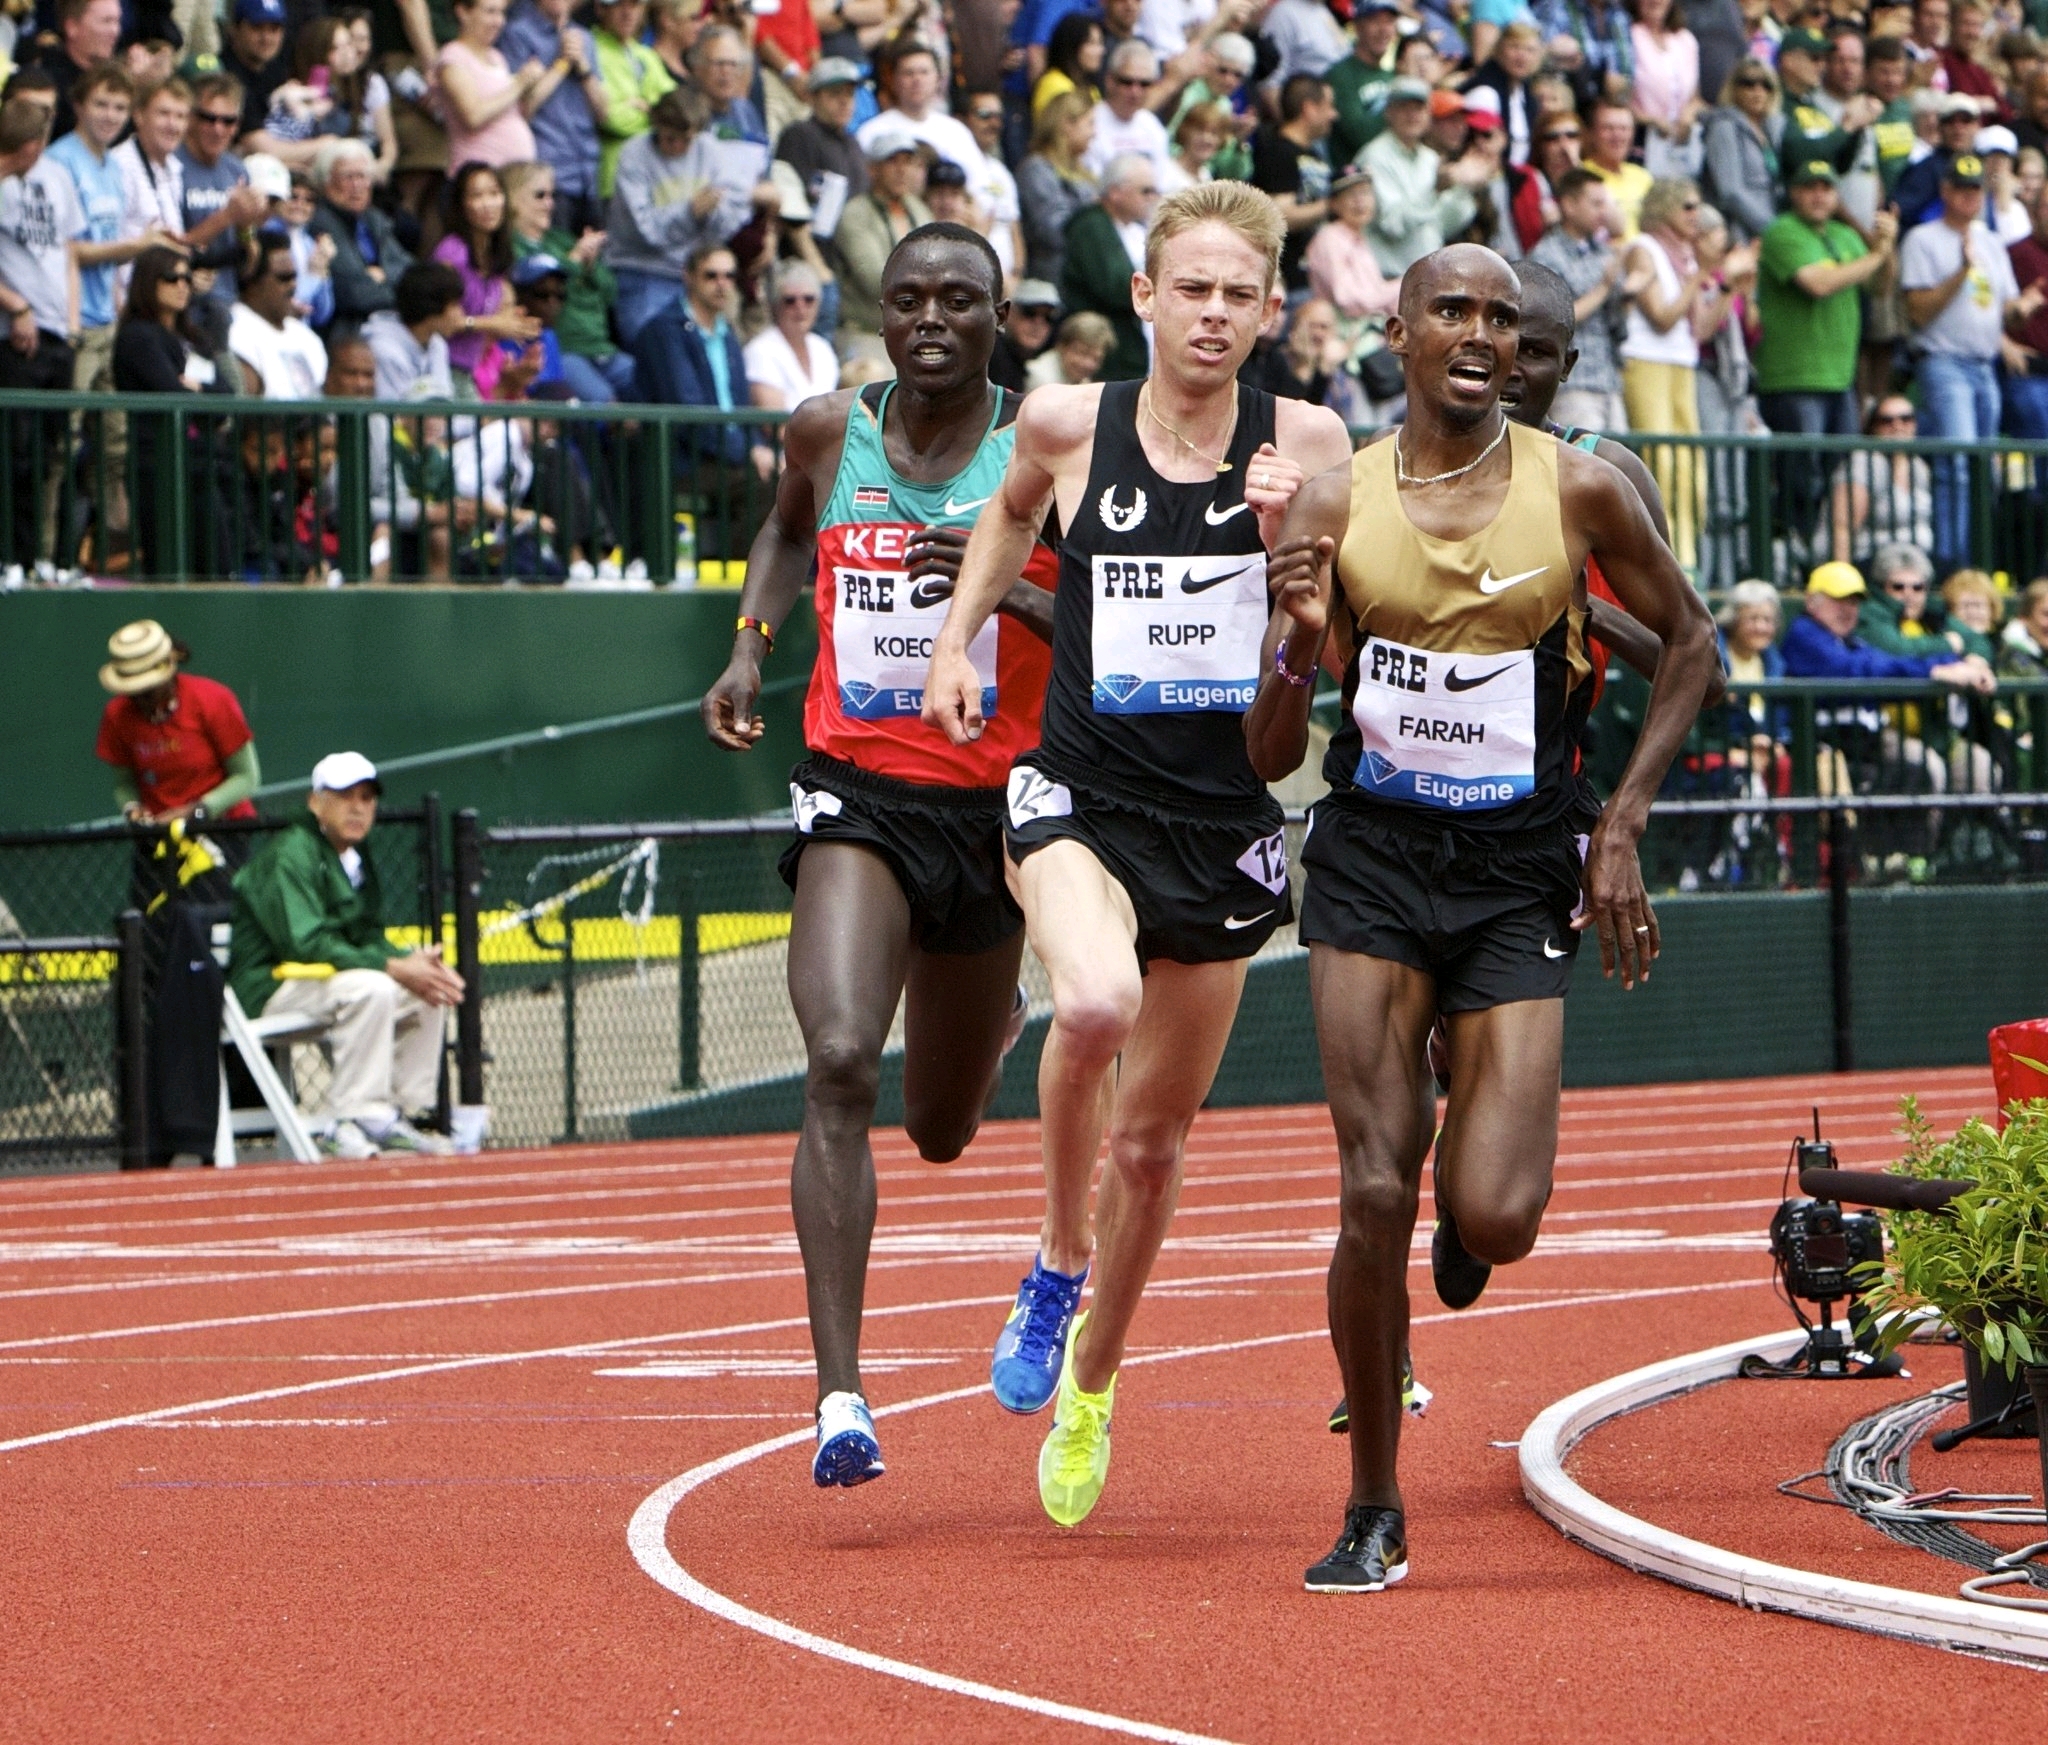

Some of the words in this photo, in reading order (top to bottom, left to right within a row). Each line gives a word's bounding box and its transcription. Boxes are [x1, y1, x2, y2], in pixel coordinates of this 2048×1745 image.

[843, 574, 895, 613] PRE
[1103, 562, 1164, 599] PRE
[874, 636, 938, 658] KOEC
[1148, 624, 1216, 646] RUPP
[1371, 644, 1428, 693] PRE
[1159, 683, 1256, 708] Eugene
[1399, 715, 1485, 744] FARAH
[1012, 770, 1055, 816] 12
[1414, 774, 1515, 807] Eugene
[1254, 833, 1285, 884] 12
